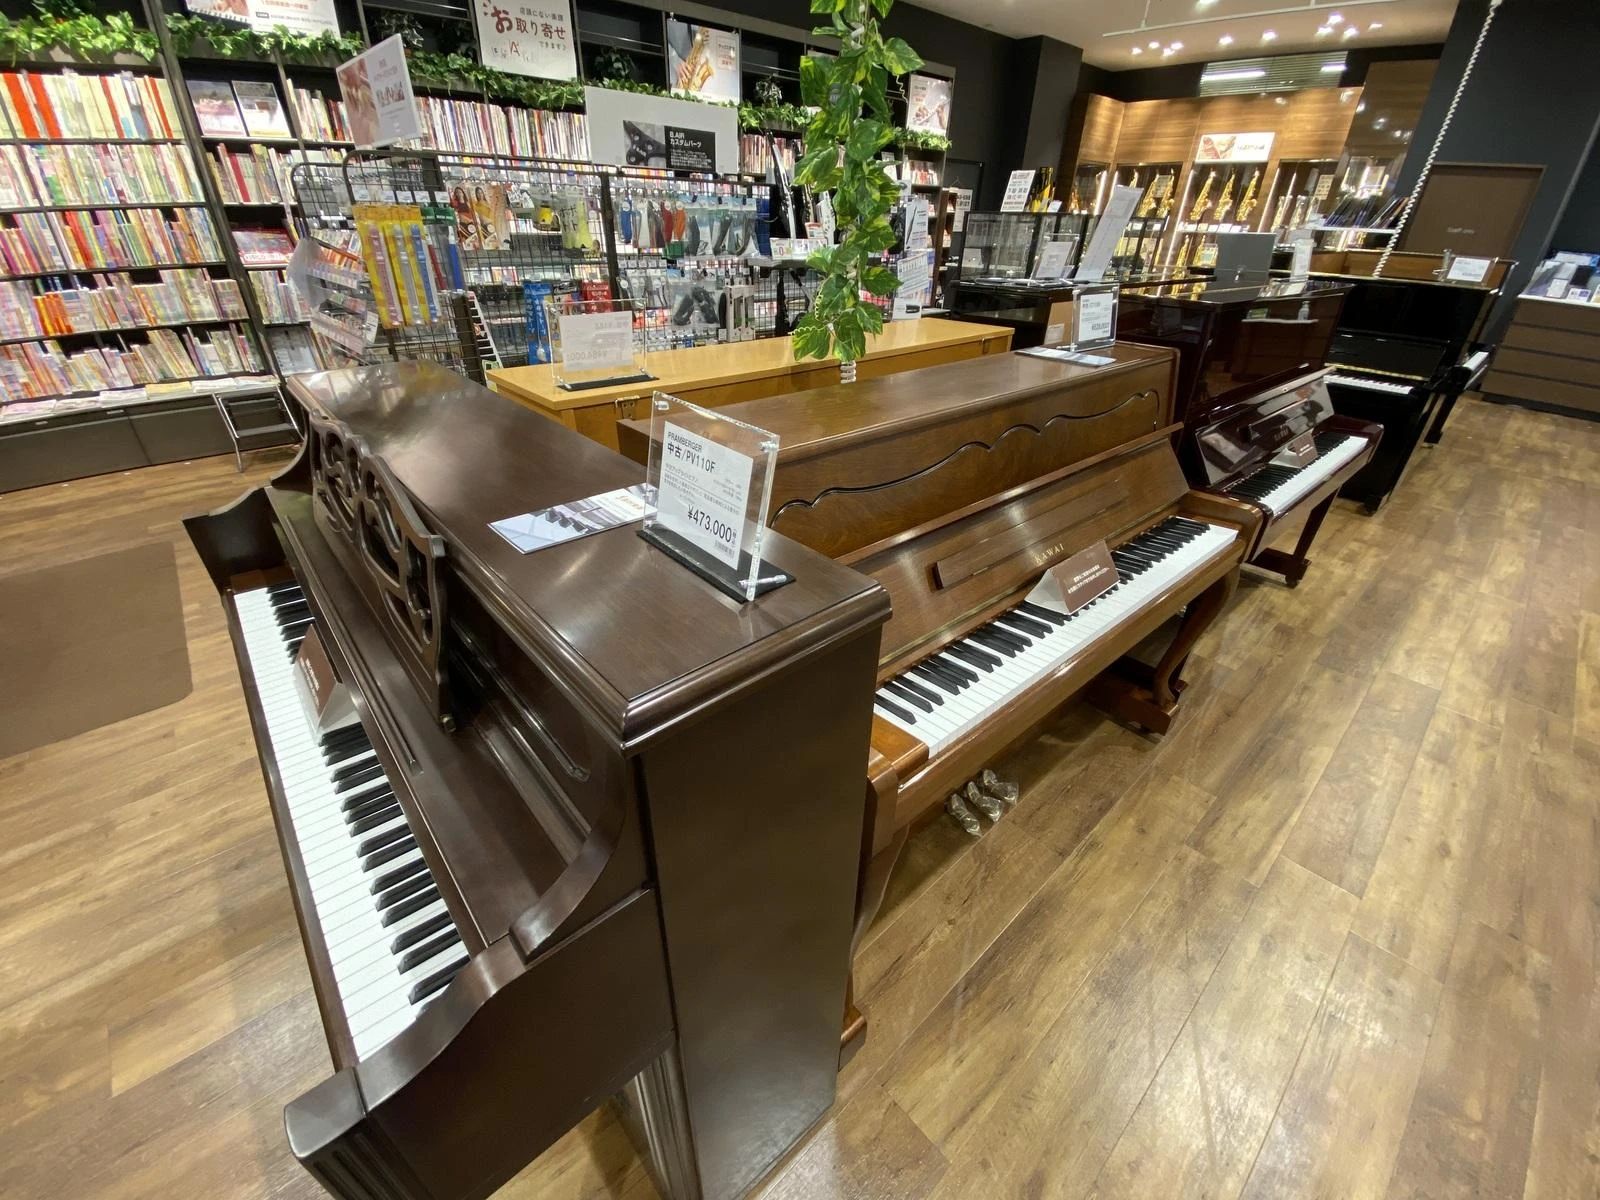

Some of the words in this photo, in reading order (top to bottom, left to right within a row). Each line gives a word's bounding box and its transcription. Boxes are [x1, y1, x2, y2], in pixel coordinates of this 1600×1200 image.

[490, 6, 566, 40] お取り寄せ
[668, 431, 703, 453] PRAMBERGER
[1034, 543, 1065, 565] KAWAI
